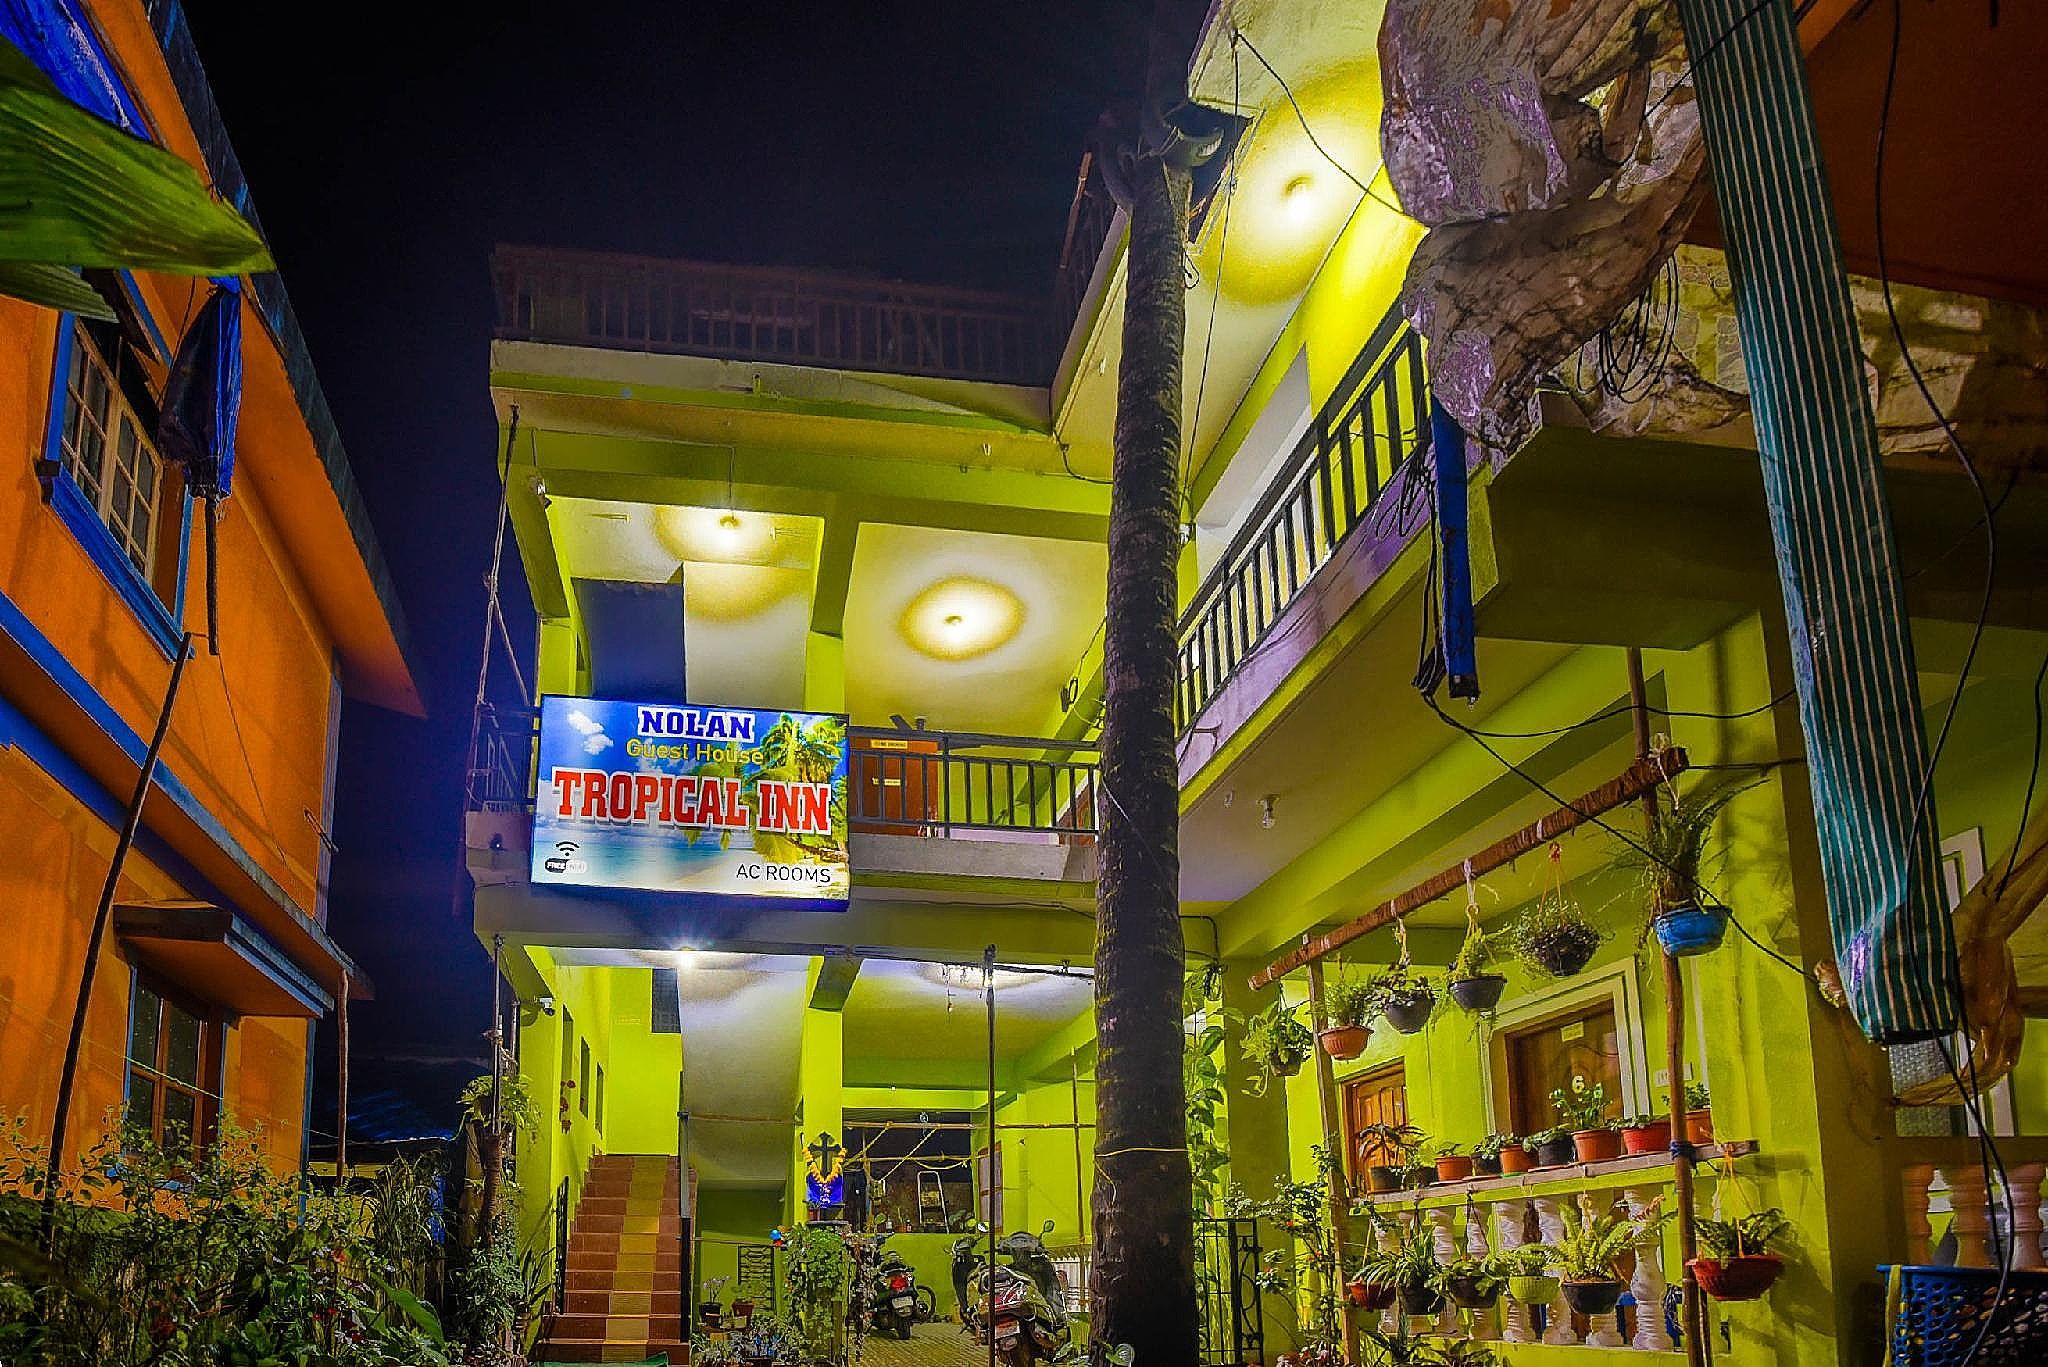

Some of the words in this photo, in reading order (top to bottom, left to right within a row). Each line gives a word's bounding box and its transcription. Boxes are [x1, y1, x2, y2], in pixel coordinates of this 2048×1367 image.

[640, 709, 752, 740] NOLAN
[626, 738, 689, 760] Guest
[696, 743, 764, 766] House
[554, 769, 747, 827] TROPICAL
[758, 783, 830, 832] INN
[736, 863, 761, 880] AC
[766, 865, 831, 883] ROOMS
[1571, 1075, 1585, 1094] 6
